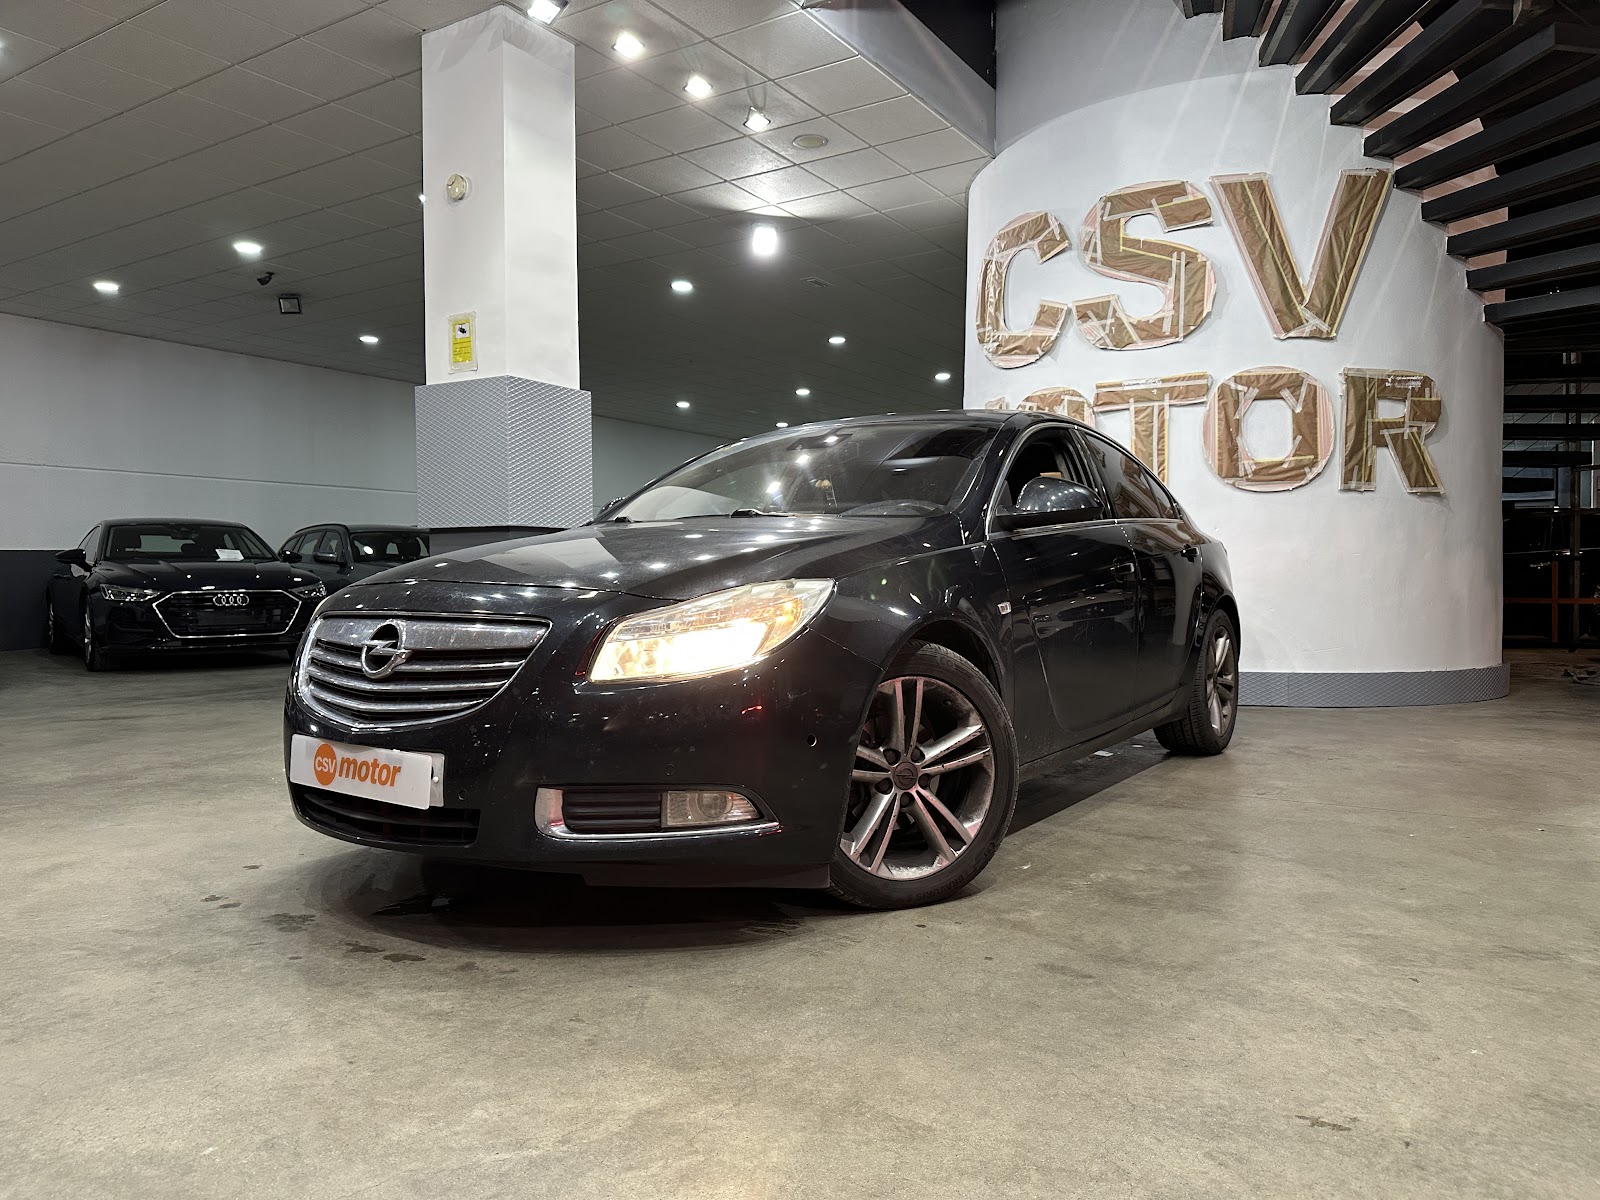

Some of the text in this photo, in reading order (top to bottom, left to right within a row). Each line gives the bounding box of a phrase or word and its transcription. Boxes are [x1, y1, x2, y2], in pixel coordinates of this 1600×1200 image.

[976, 167, 1395, 368] CSV
[985, 366, 1445, 494] TOR
[338, 756, 401, 787] motor
